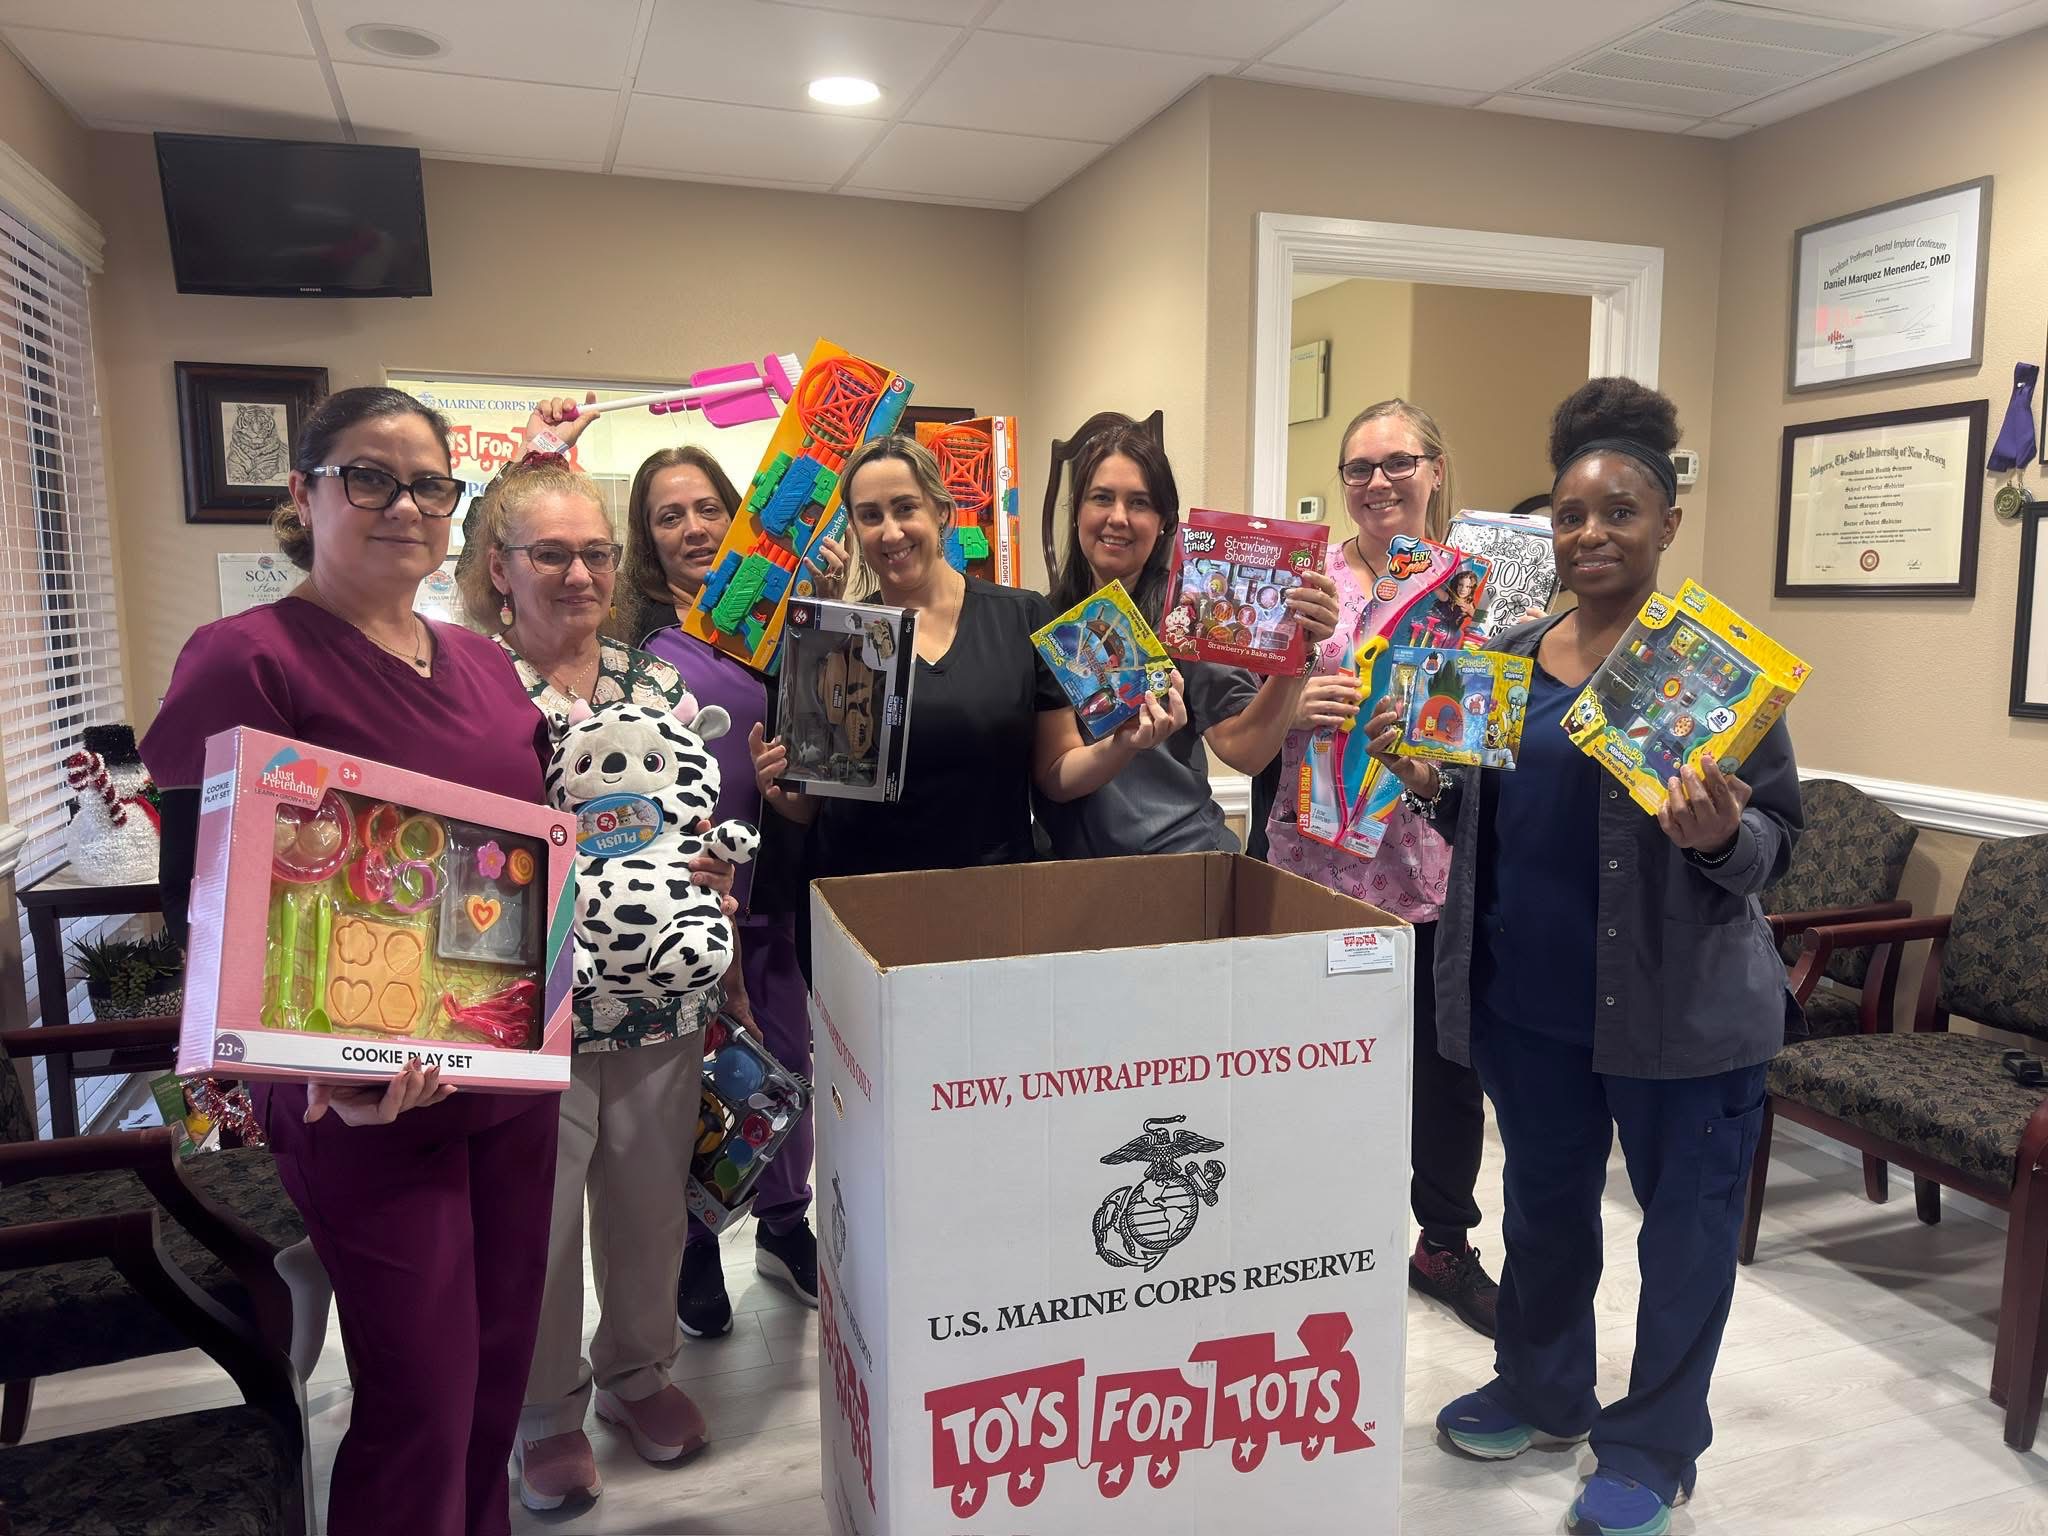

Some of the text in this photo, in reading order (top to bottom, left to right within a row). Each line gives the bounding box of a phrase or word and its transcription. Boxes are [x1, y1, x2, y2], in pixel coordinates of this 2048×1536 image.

[1875, 241, 1892, 254] Dental
[1894, 238, 1915, 251] Implant
[1916, 237, 1947, 250] Continuum
[1823, 275, 1847, 290] Daniel
[1848, 270, 1881, 285] Marquez
[1883, 259, 1928, 277] Menendez,
[1929, 253, 1951, 267] DMD
[438, 399, 486, 410] MARINE
[487, 400, 526, 411] CORPS
[479, 436, 514, 458] FOR
[1182, 528, 1213, 543] Teeny
[1184, 539, 1216, 553] Tinies!
[1224, 536, 1282, 560] Strawberry
[1224, 548, 1276, 567] Shortcake
[1296, 556, 1311, 568] 20
[246, 570, 288, 582] SCAN
[1487, 558, 1538, 592] JOY
[1207, 641, 1287, 662] Strawberry's Bake Shop
[1717, 711, 1728, 723] 20
[272, 765, 294, 781] Just
[343, 768, 358, 781] 3+
[206, 781, 231, 794] COOKIE
[262, 772, 319, 798] Pretending
[204, 789, 231, 804] PLAY SET
[1299, 813, 1309, 828] SET
[552, 832, 564, 842] $5
[596, 832, 637, 850] PLUSH
[217, 1042, 233, 1056] 23
[342, 1046, 473, 1069] COOKIE PLAY SET
[930, 1037, 1378, 1111] NEW, UNWRAPPED TOYS ONLY
[928, 1248, 1377, 1341] U.S. MARINE CORPS RESERVE
[941, 1366, 1342, 1465] TOYS FOR TOTS
[1364, 1420, 1377, 1432] SM
